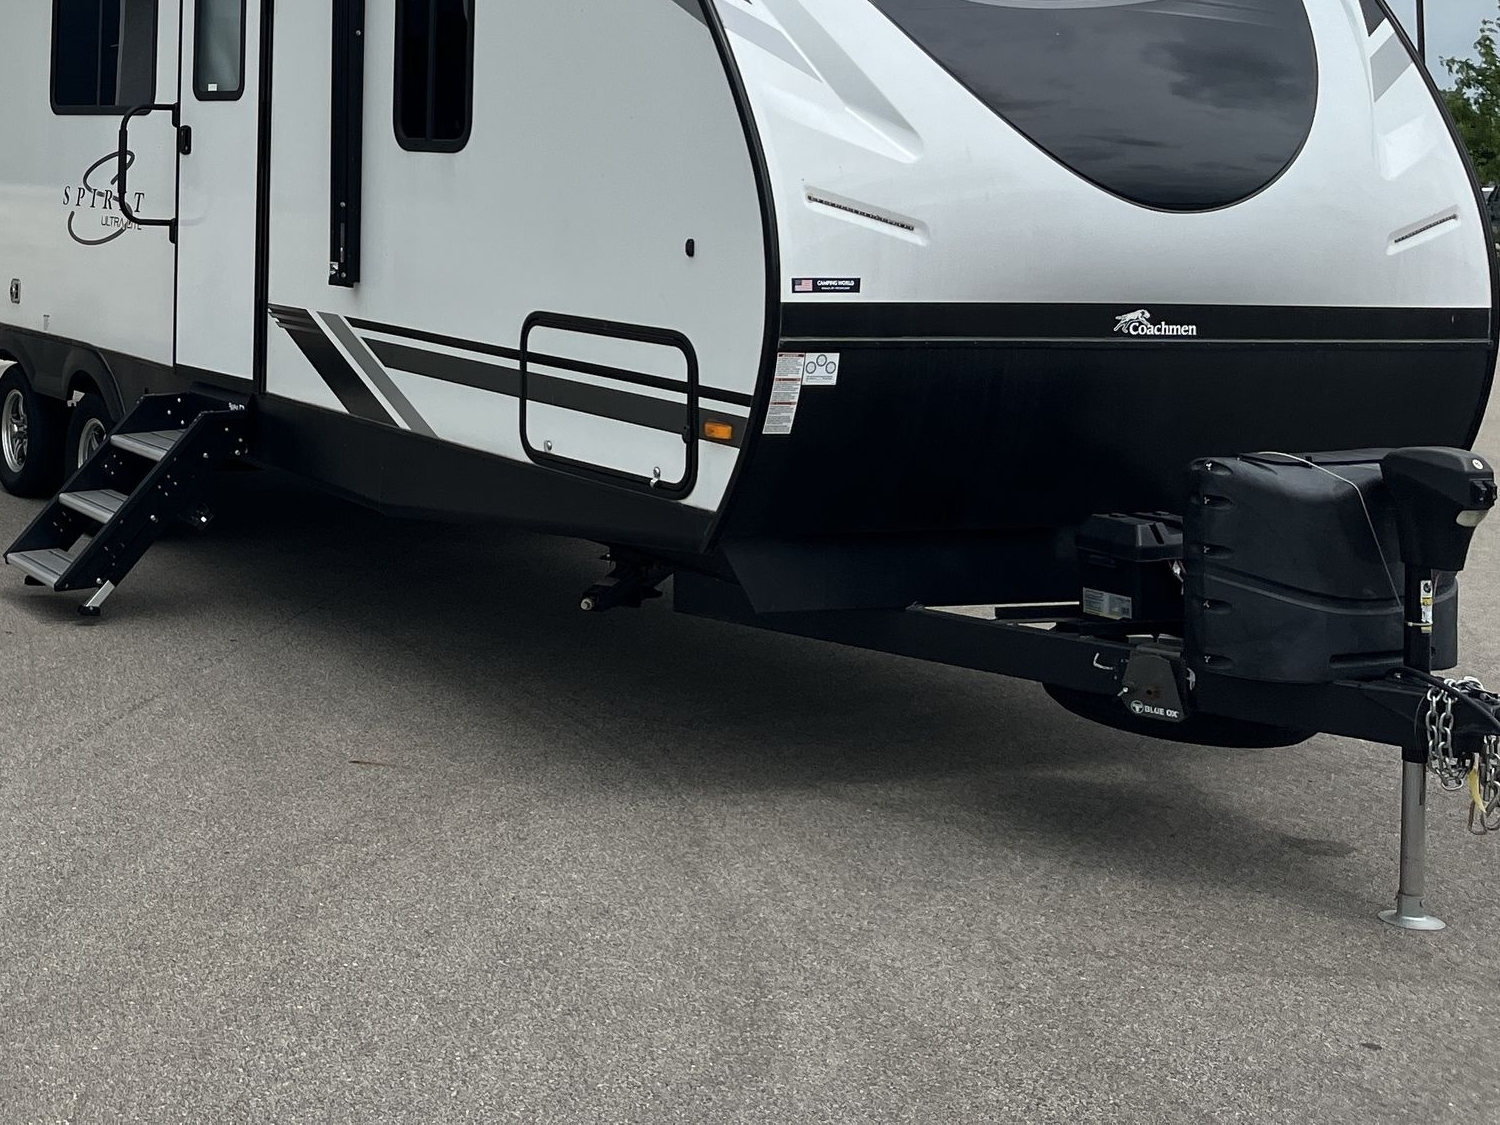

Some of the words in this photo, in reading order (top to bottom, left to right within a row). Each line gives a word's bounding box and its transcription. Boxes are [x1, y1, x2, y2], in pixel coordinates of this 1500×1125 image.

[62, 185, 145, 213] SPIRT
[1129, 321, 1197, 336] Coachmen
[1144, 705, 1165, 716] BLUE
[1166, 709, 1179, 718] OX
